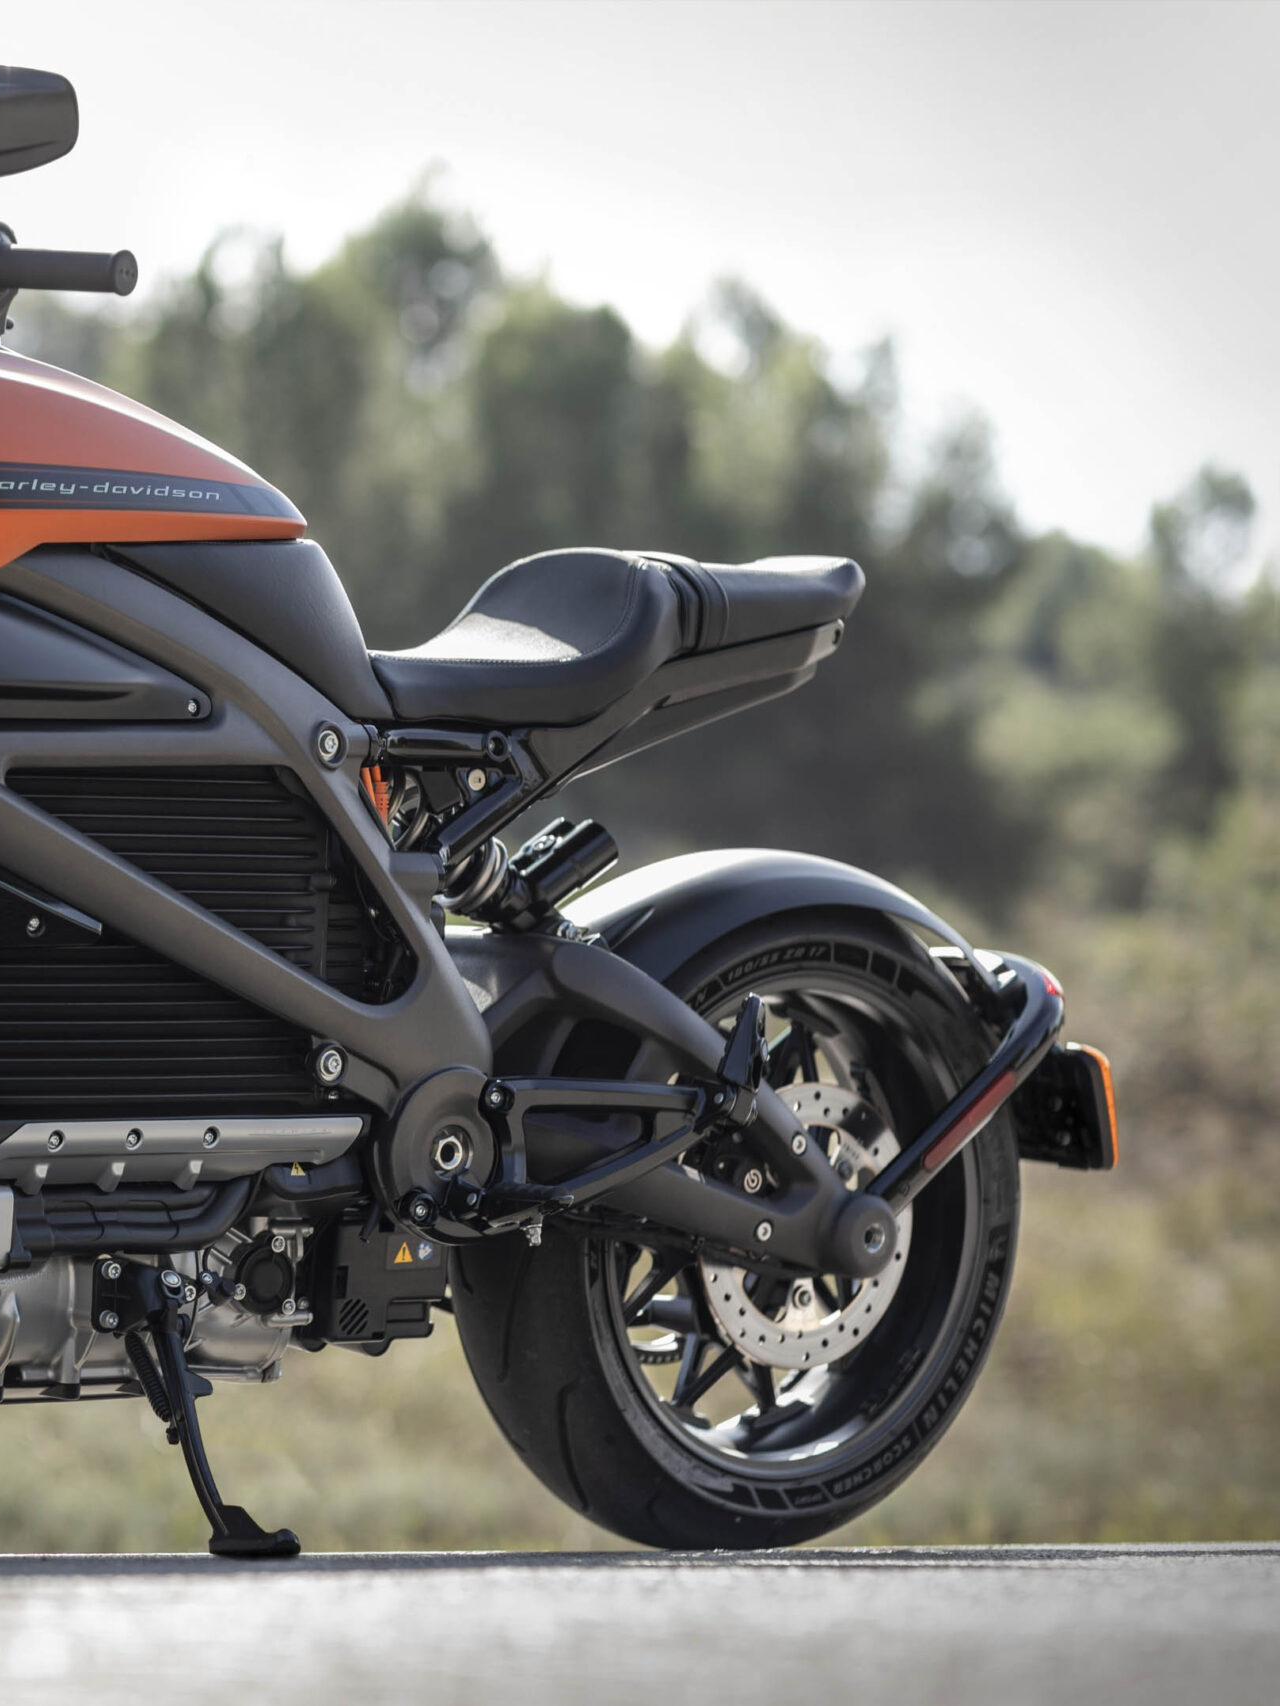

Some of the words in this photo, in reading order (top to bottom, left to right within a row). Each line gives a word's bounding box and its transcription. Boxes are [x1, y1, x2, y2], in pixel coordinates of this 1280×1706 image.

[727, 953, 779, 982] 180/55
[783, 946, 806, 960] ZR
[809, 945, 827, 957] 17
[923, 1272, 999, 1430] MICHELIN
[832, 1433, 912, 1495] SCORCHER
